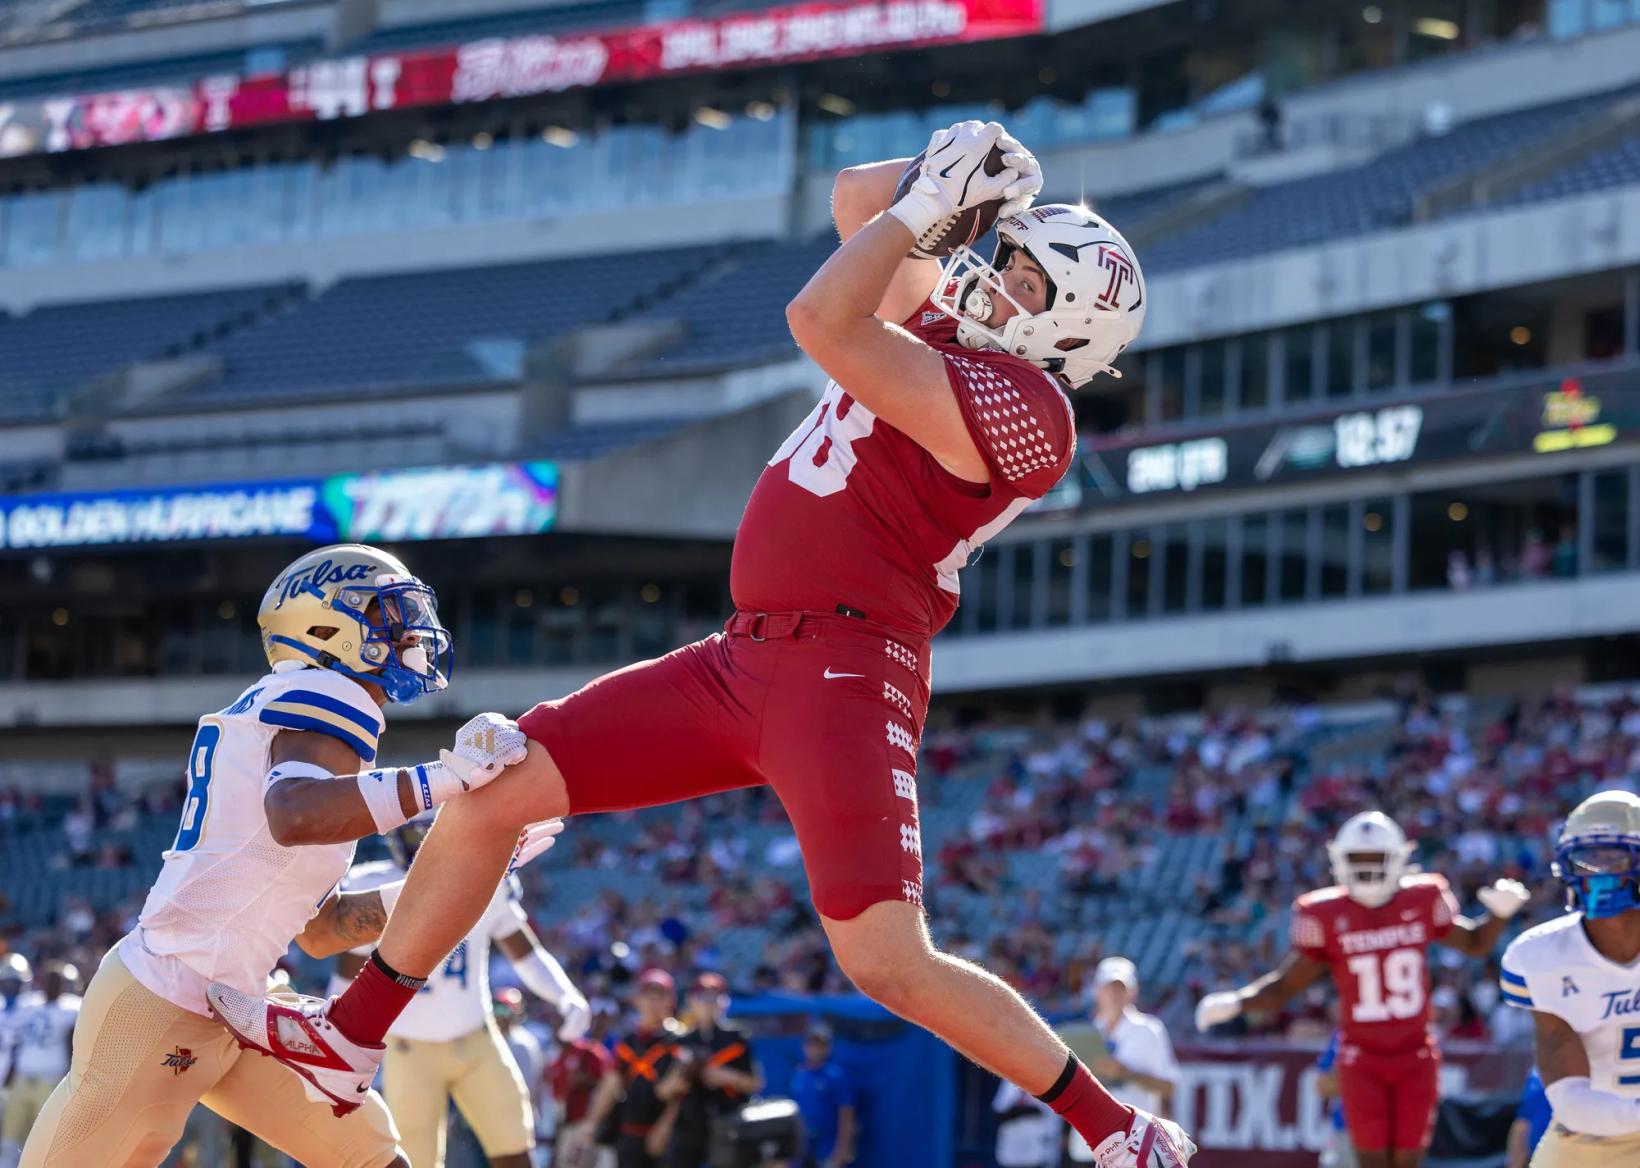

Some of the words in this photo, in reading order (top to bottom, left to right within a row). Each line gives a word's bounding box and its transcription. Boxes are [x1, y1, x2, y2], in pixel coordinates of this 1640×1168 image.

[275, 560, 377, 611] Tulsa
[1337, 922, 1426, 954] TEMPLE
[1347, 948, 1426, 1022] 19
[284, 1037, 322, 1055] ALPHA
